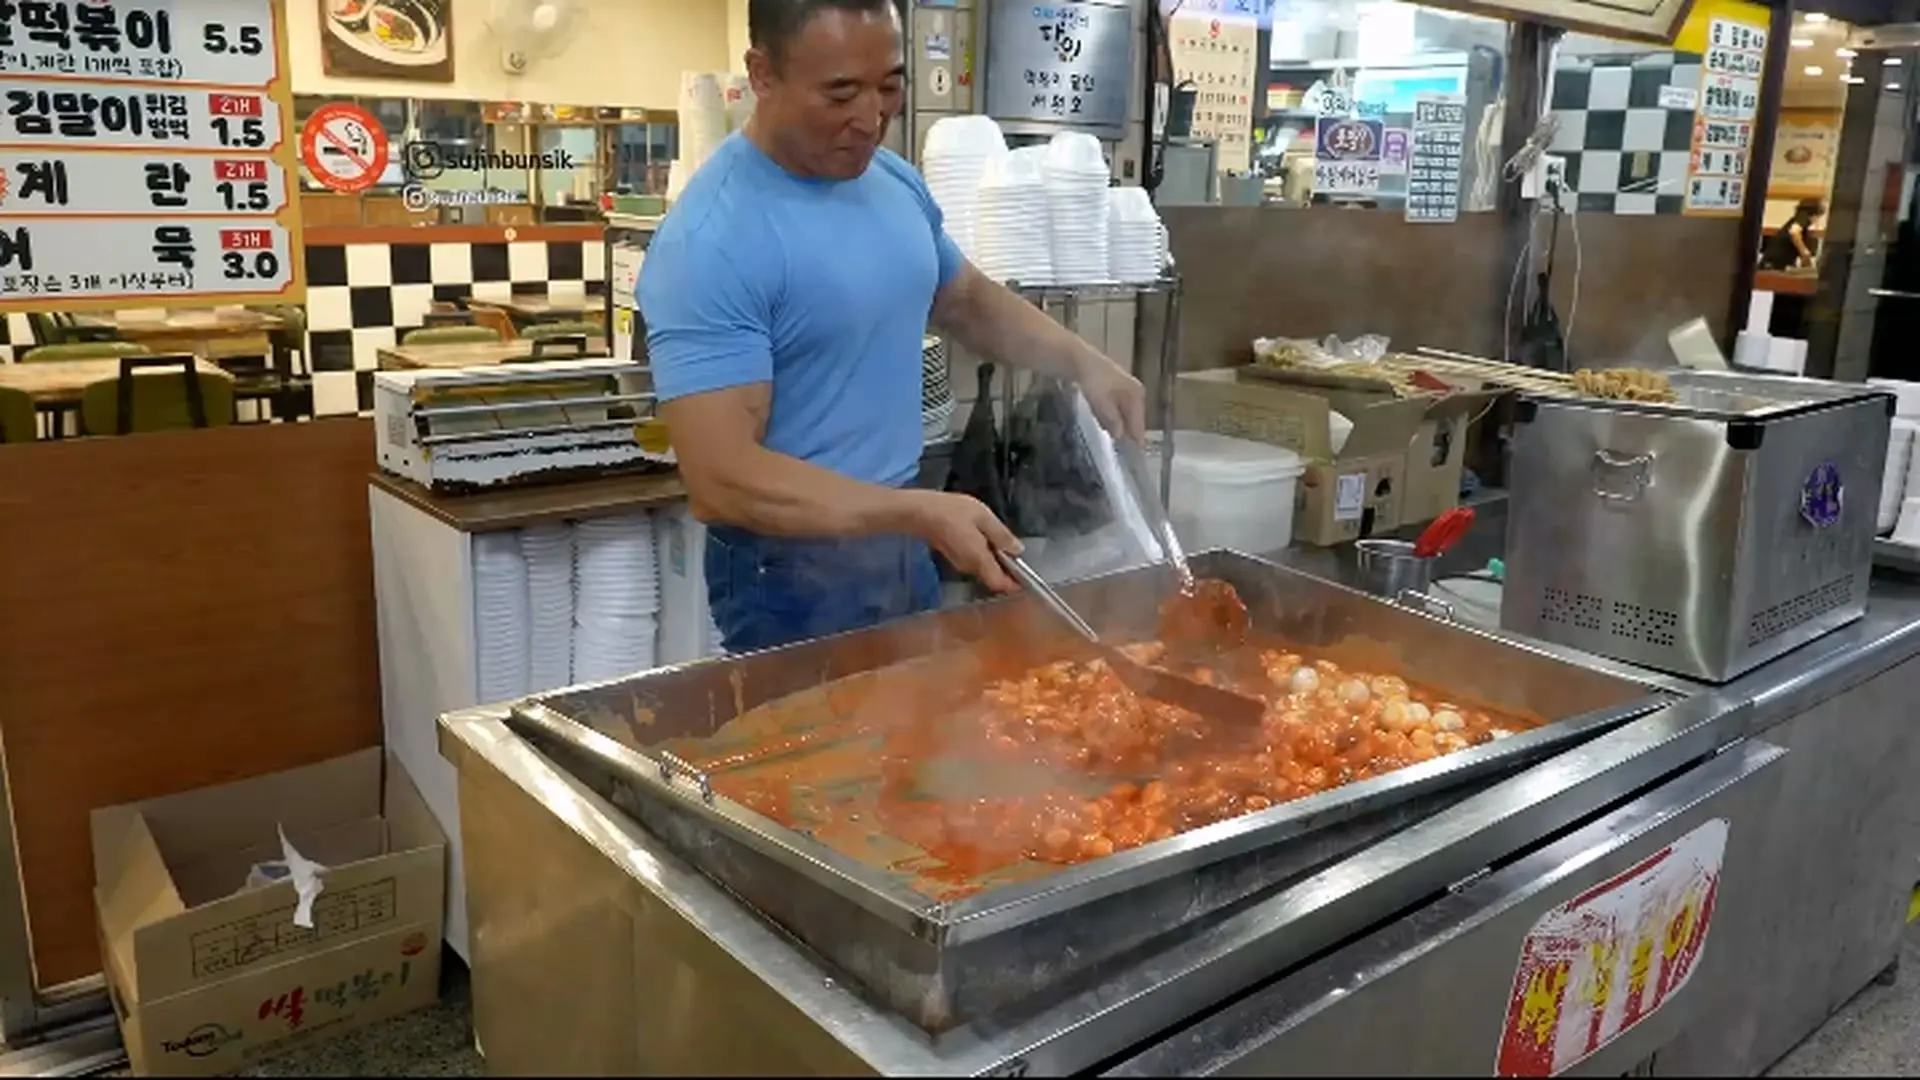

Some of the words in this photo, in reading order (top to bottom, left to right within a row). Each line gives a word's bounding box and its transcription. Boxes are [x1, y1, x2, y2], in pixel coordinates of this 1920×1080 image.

[204, 24, 262, 55] 5.5
[6, 91, 142, 136] 김말이
[221, 96, 250, 113] 2개
[146, 94, 187, 115] 튀김
[211, 118, 265, 147] 1.5
[225, 163, 256, 179] 2개
[216, 182, 269, 210] 1.5
[231, 232, 261, 248] 3개
[223, 252, 278, 278] 3.0
